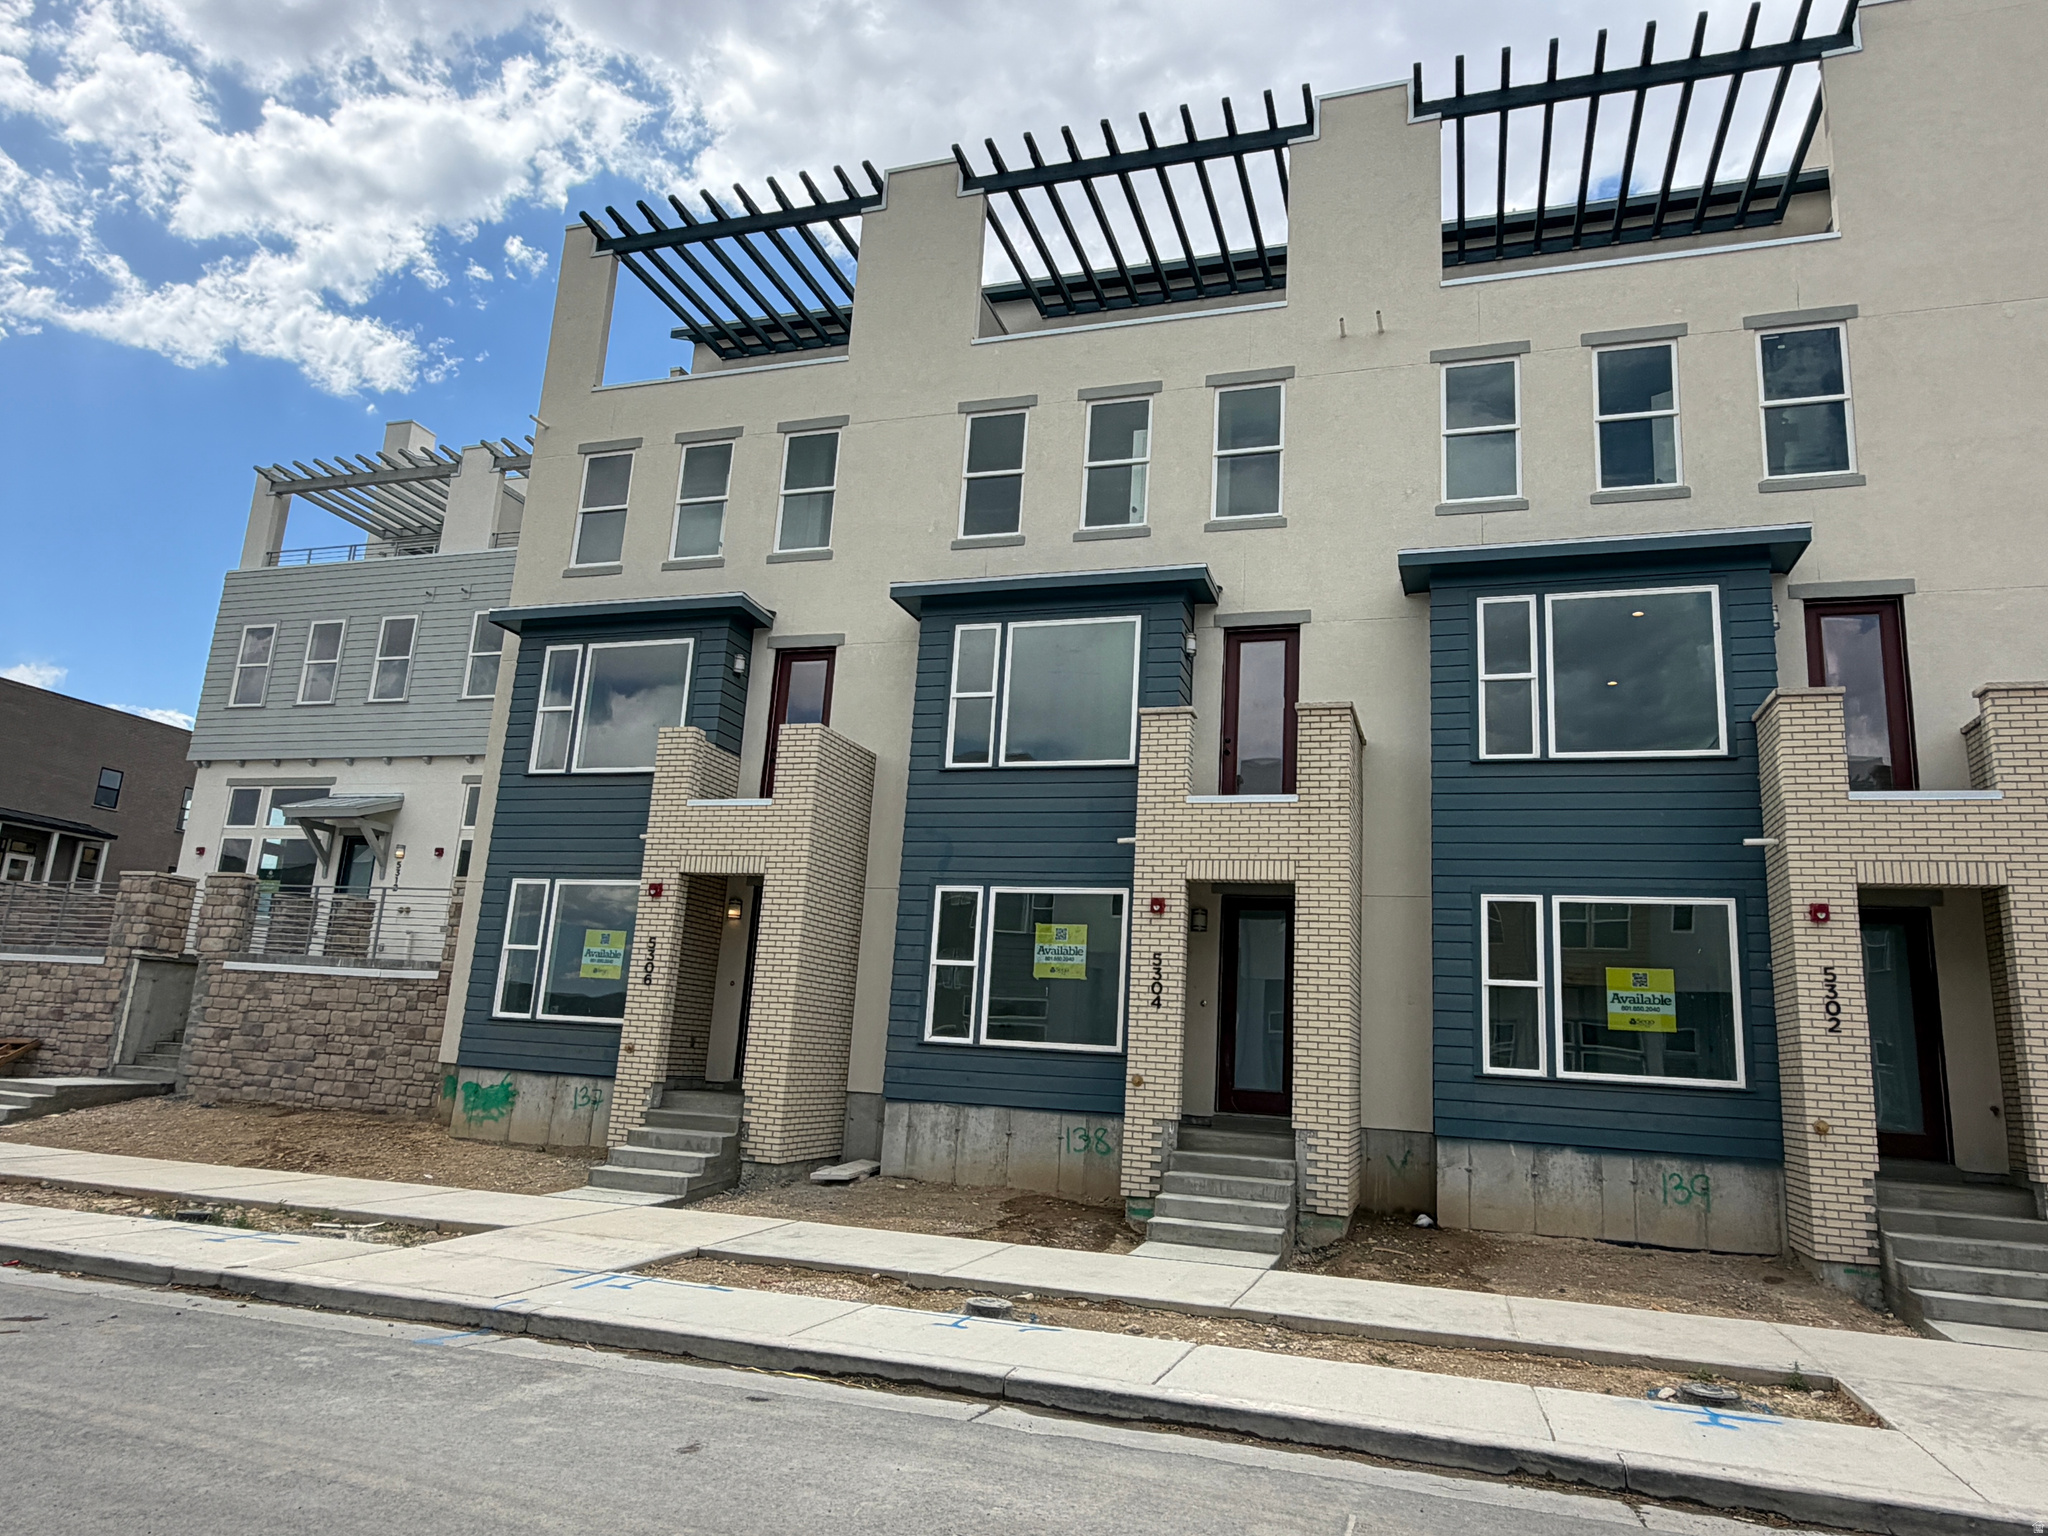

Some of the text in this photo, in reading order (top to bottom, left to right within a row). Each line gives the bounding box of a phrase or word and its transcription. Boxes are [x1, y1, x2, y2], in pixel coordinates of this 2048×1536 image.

[584, 948, 622, 959] Available
[643, 936, 657, 986] 5306
[1037, 945, 1084, 957] Available
[1151, 952, 1163, 1010] 5304
[1610, 992, 1672, 1006] Available
[1823, 966, 1842, 1033] 5302
[1066, 1126, 1112, 1156] 138
[1662, 1172, 1711, 1213] 139
